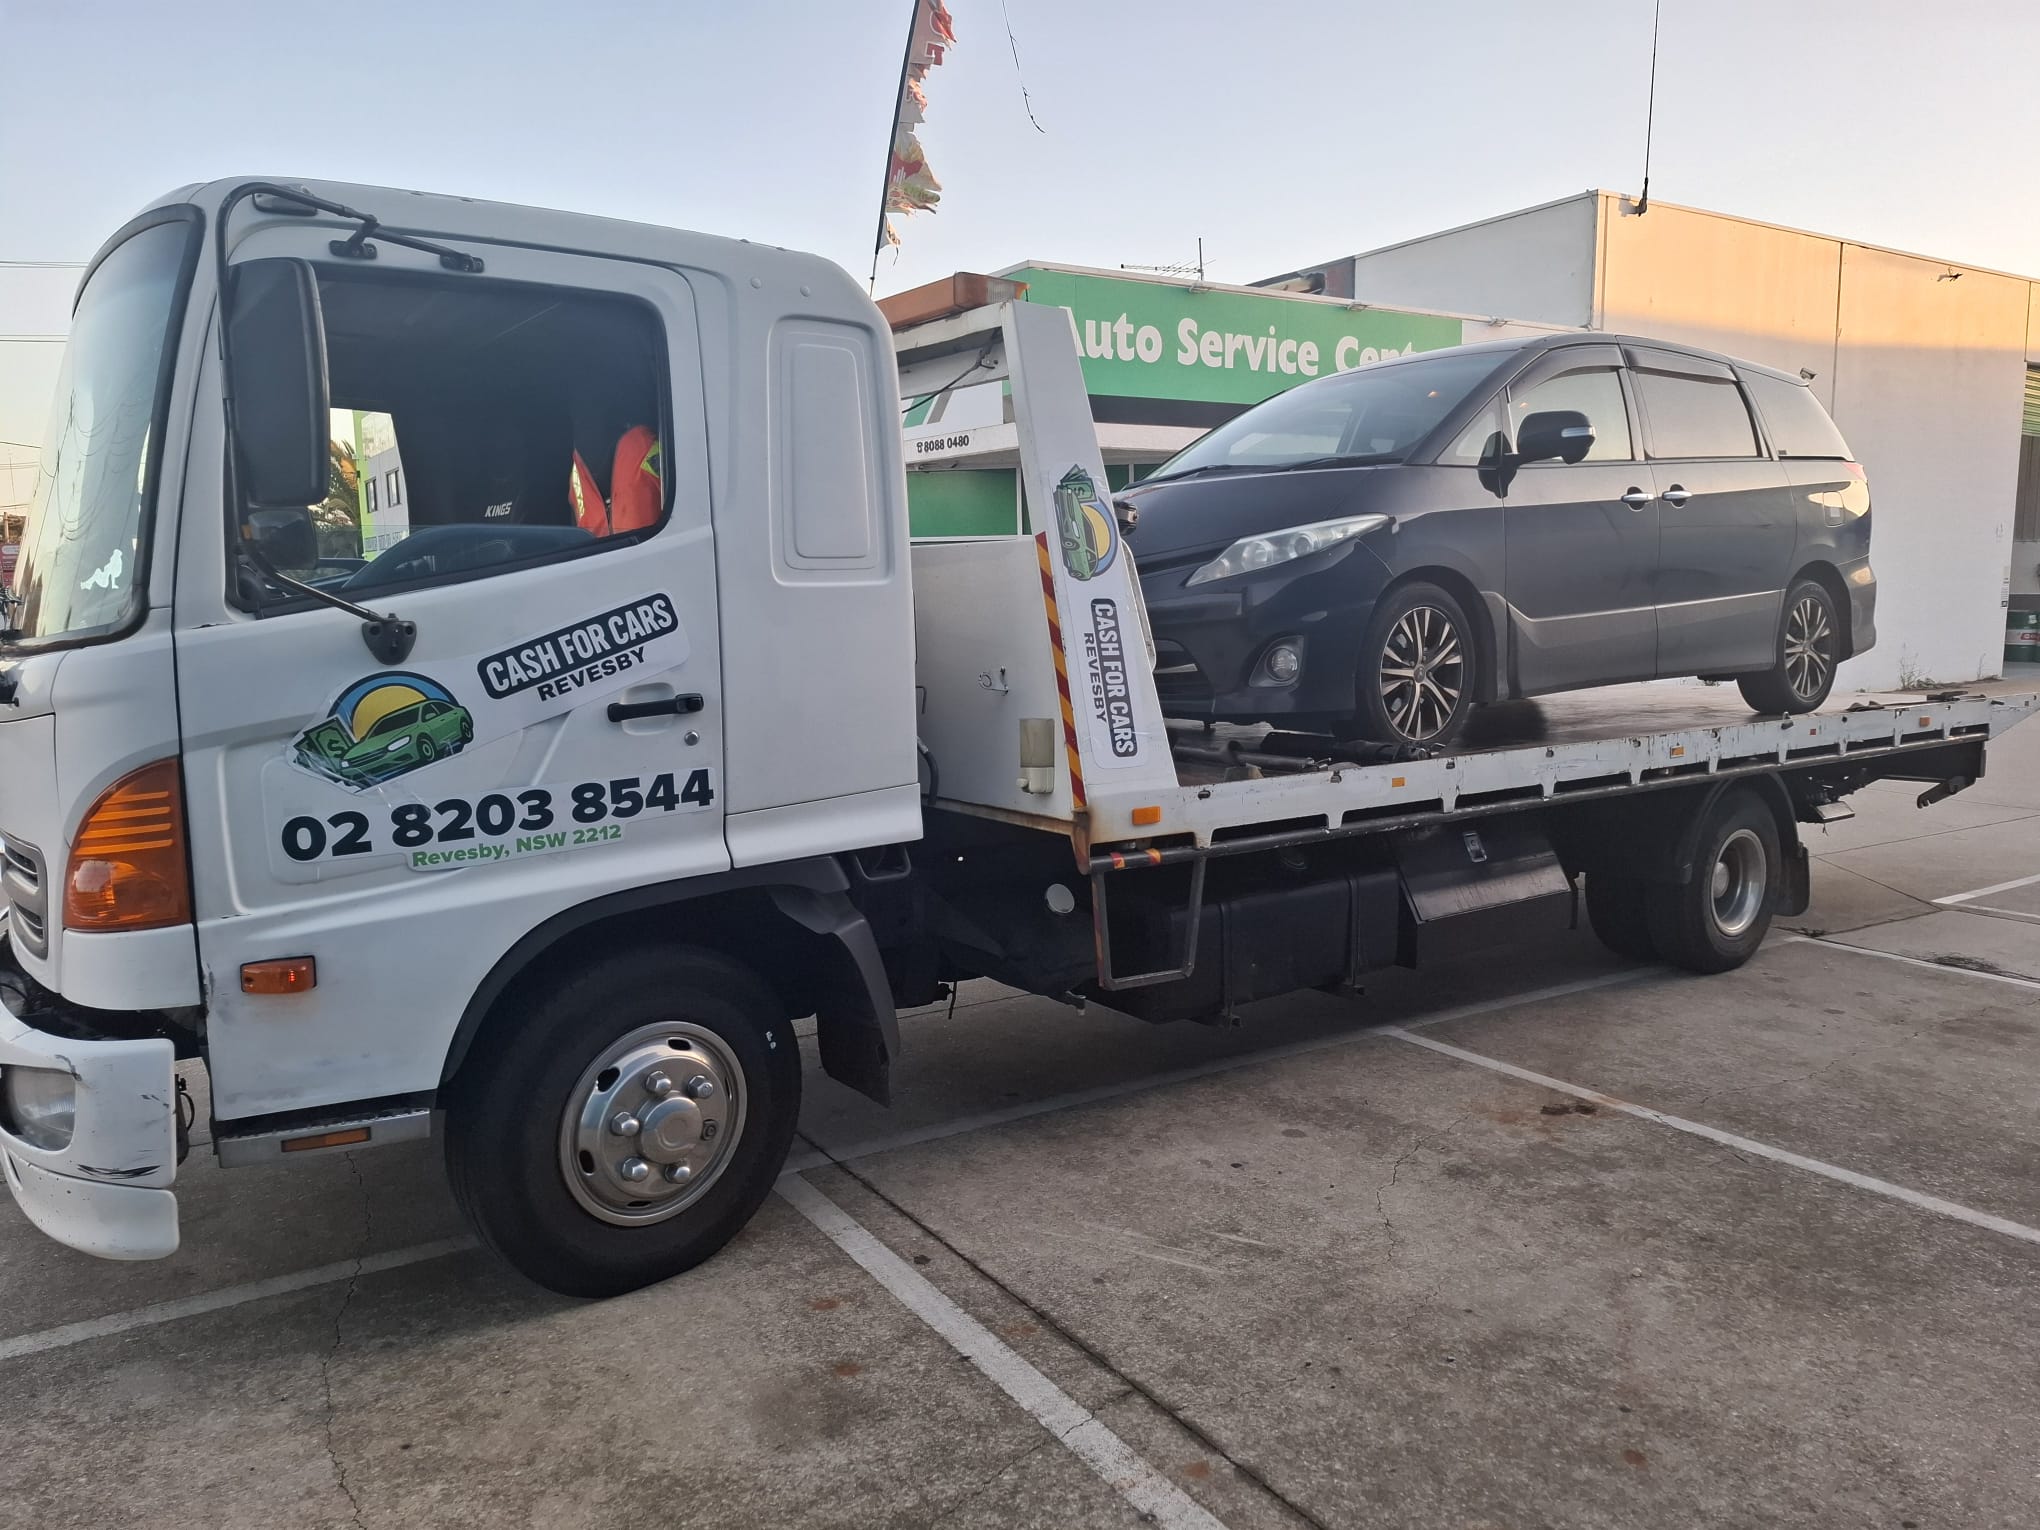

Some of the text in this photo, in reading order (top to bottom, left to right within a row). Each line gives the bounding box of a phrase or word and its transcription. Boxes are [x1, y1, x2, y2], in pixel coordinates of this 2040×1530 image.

[1177, 317, 1319, 376] Service
[923, 434, 970, 453] 8088 0480
[484, 501, 513, 518] KINGS
[486, 599, 673, 692] CASH FOR CARS
[536, 646, 646, 702] REVESBY
[1083, 632, 1108, 723] REVESBY
[1094, 603, 1135, 755] CASH FOR CARS
[281, 768, 714, 862] 02 8203 8544
[412, 824, 622, 867] Revesby, NSW 2212
